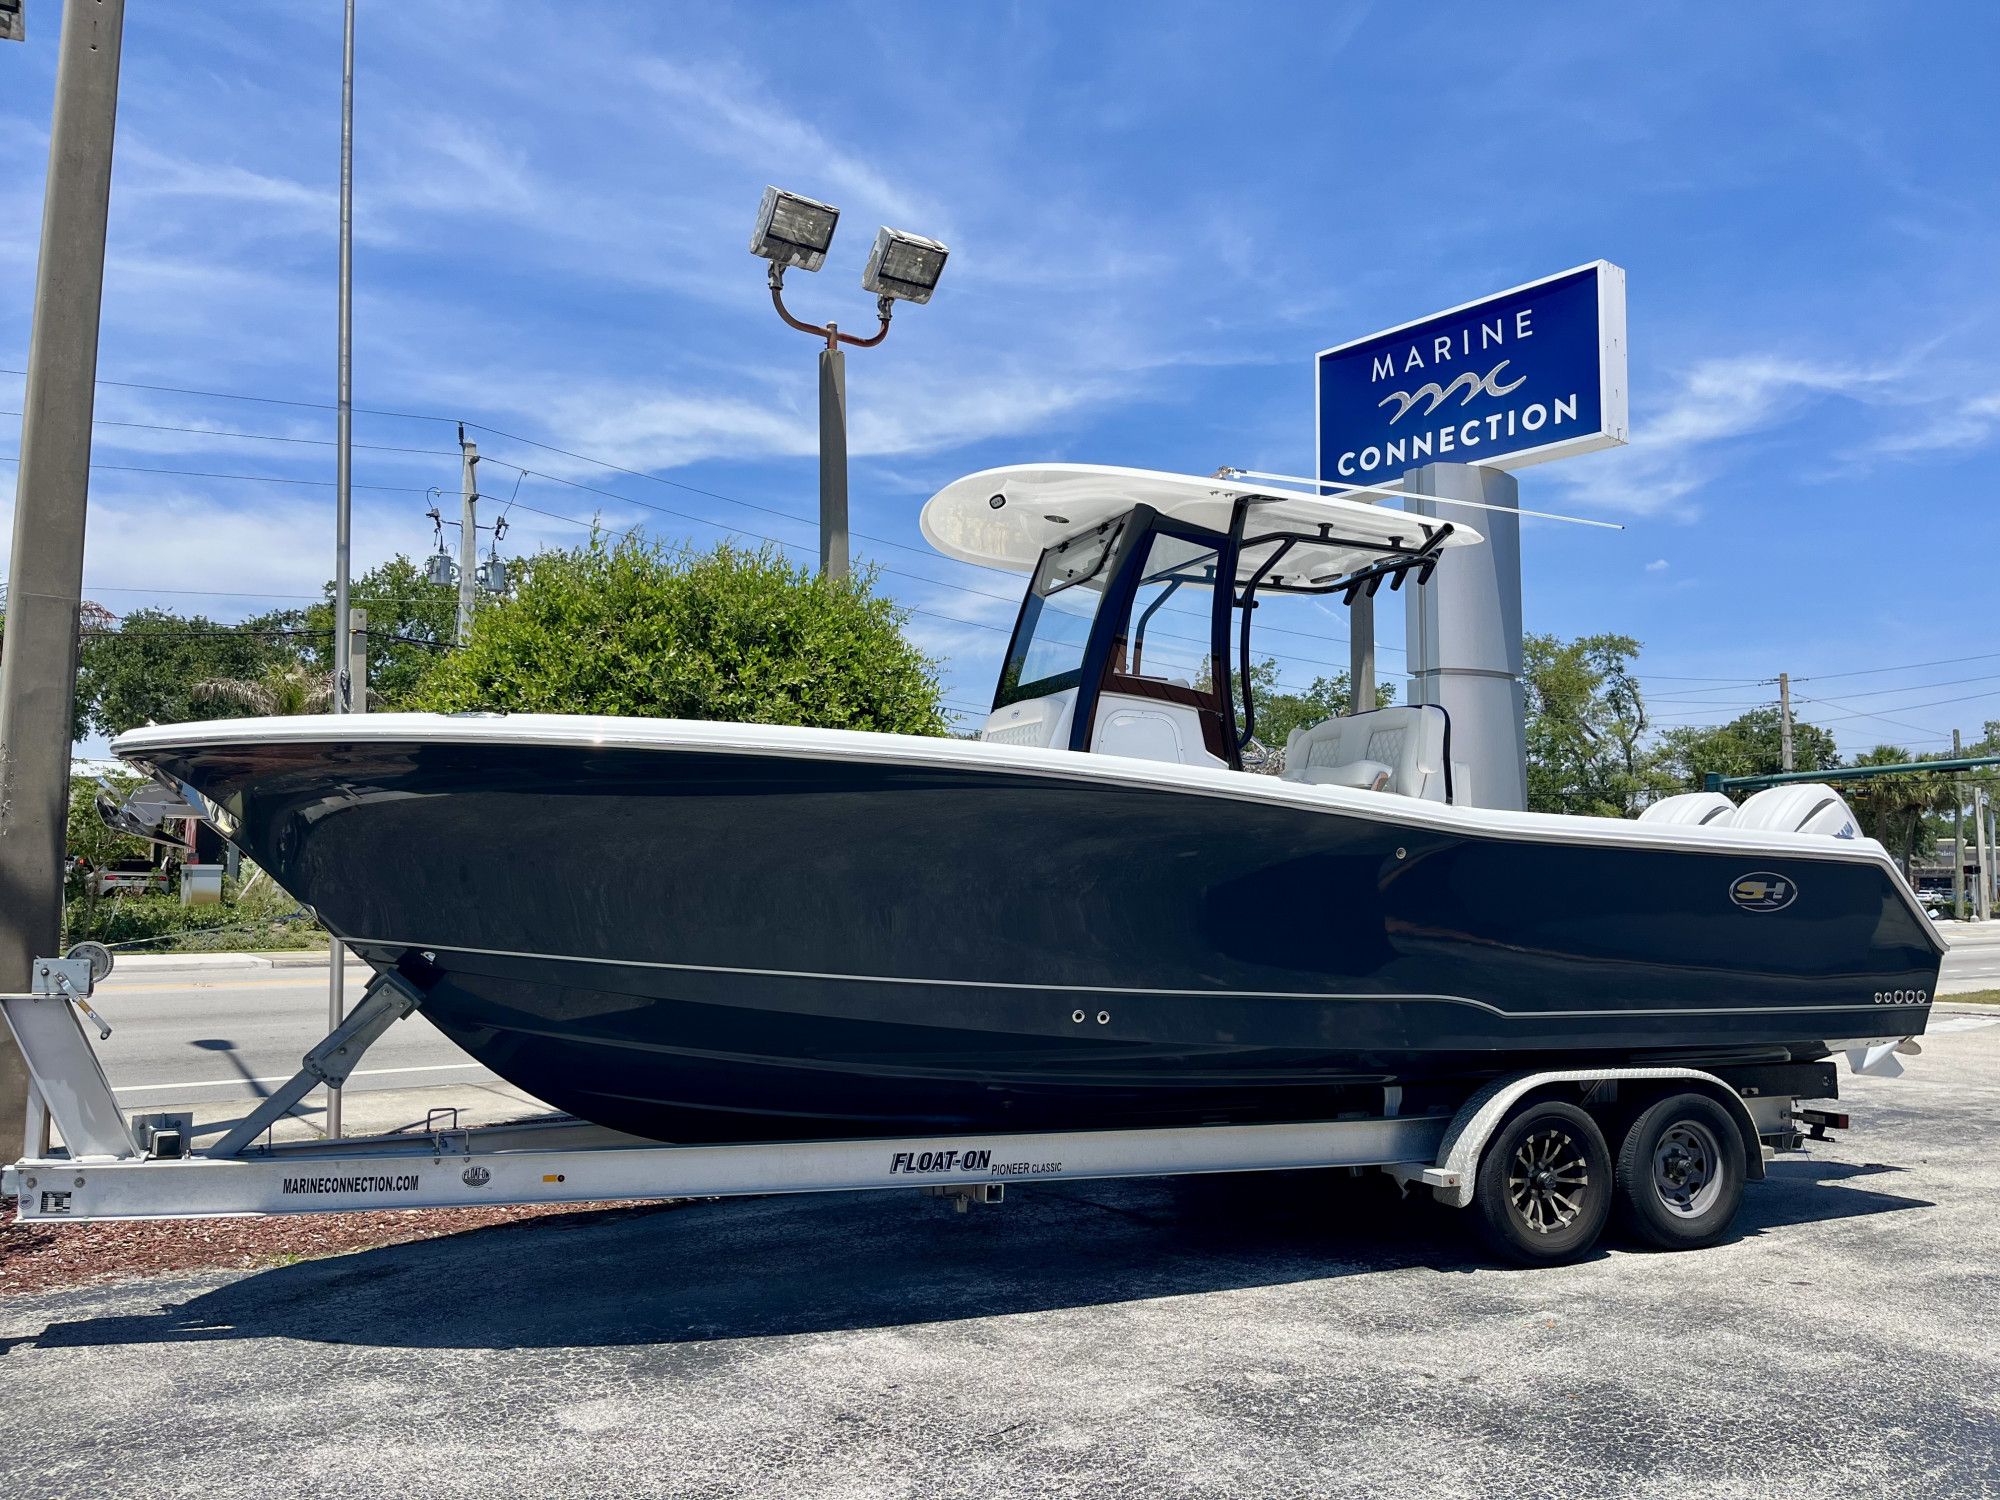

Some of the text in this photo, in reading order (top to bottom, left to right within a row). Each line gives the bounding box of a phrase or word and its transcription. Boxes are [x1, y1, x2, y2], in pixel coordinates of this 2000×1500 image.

[1371, 309, 1533, 382] MARINE
[1337, 393, 1577, 476] CONNECTION
[890, 1149, 992, 1174] FLOAT-ON
[991, 1161, 1063, 1176] PIONEER CLASSIC
[282, 1175, 419, 1195] MARINECONNECTION.COM
